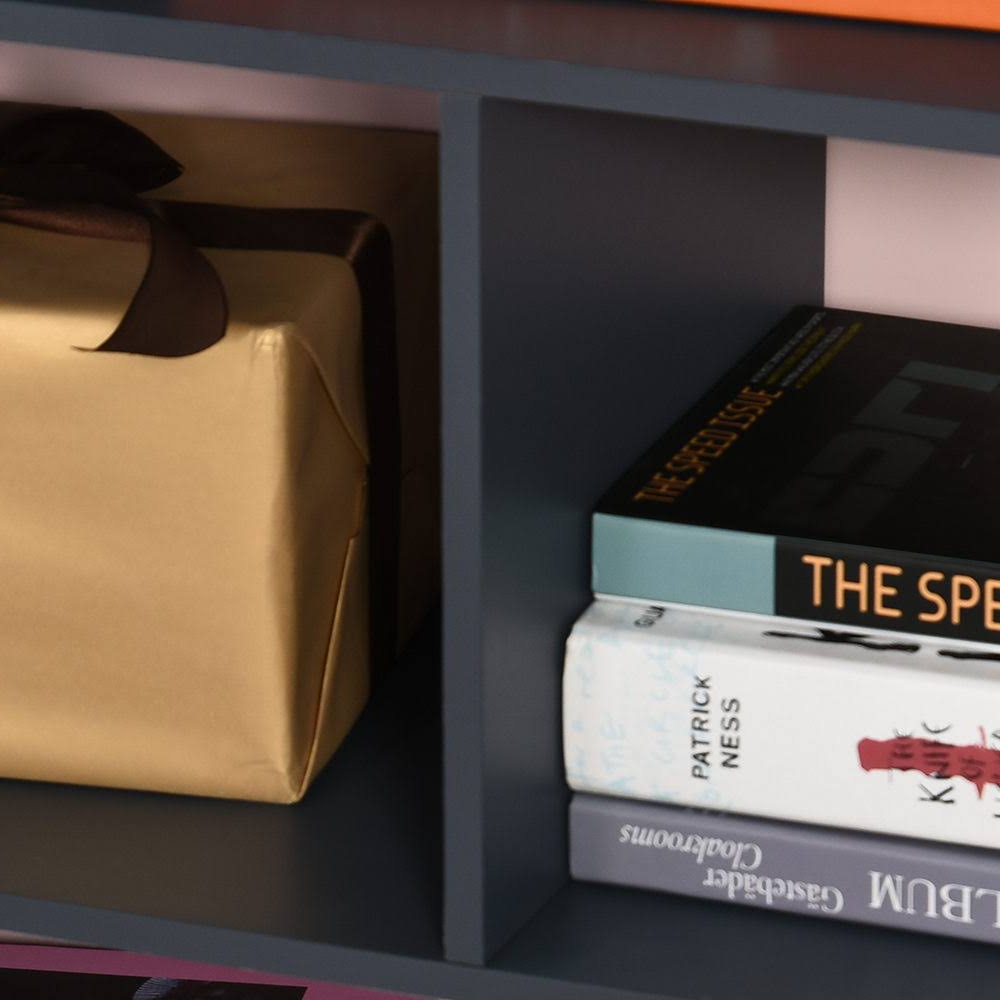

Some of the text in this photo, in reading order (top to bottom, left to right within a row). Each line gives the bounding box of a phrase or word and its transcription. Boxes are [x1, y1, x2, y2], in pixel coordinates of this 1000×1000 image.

[633, 386, 784, 503] THE SPEED ISSUE
[802, 554, 902, 617] THE
[690, 675, 711, 780] PATRICK
[721, 698, 741, 769] NESS
[618, 823, 763, 871] Cloakrooms
[703, 867, 845, 914] Gästebäder
